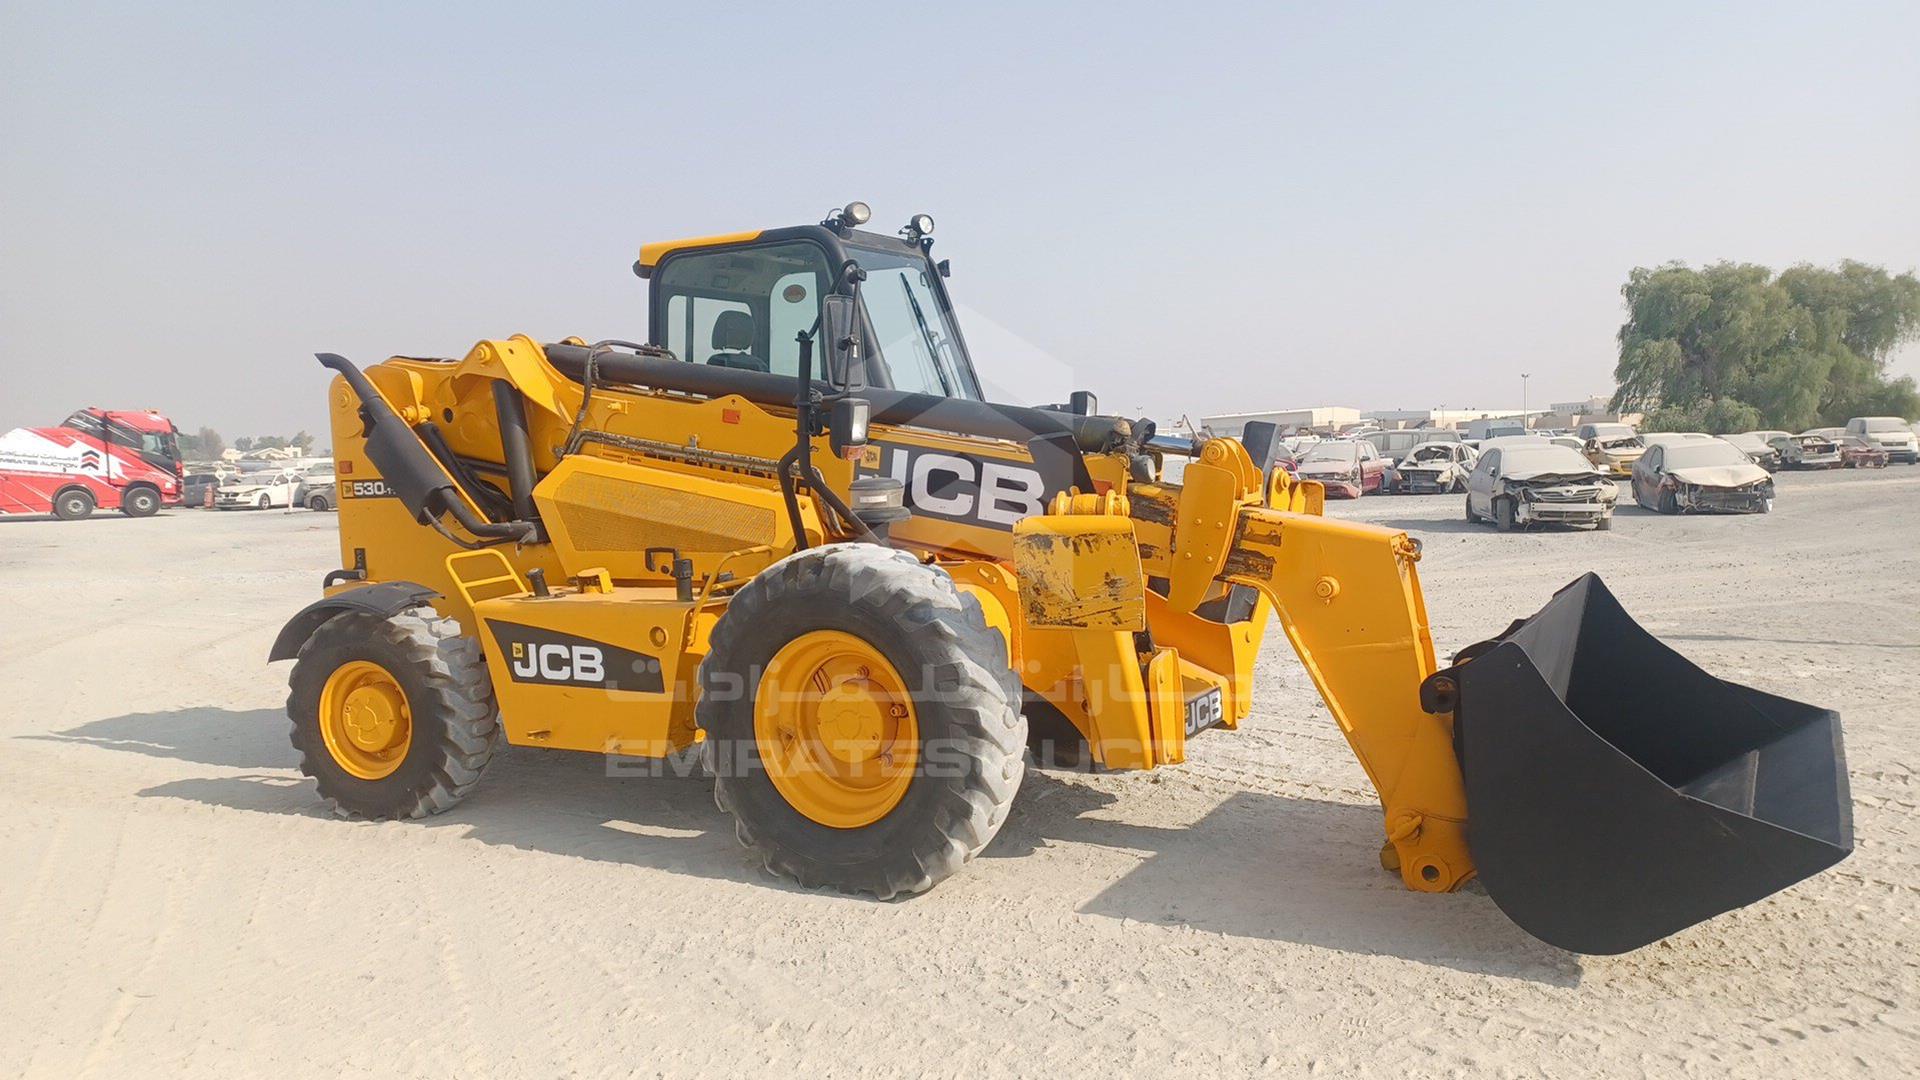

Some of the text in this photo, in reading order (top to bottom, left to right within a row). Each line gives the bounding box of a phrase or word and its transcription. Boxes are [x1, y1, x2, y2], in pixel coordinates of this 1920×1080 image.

[353, 481, 396, 496] 530-1
[513, 643, 605, 682] JCB
[1185, 690, 1222, 736] JCB
